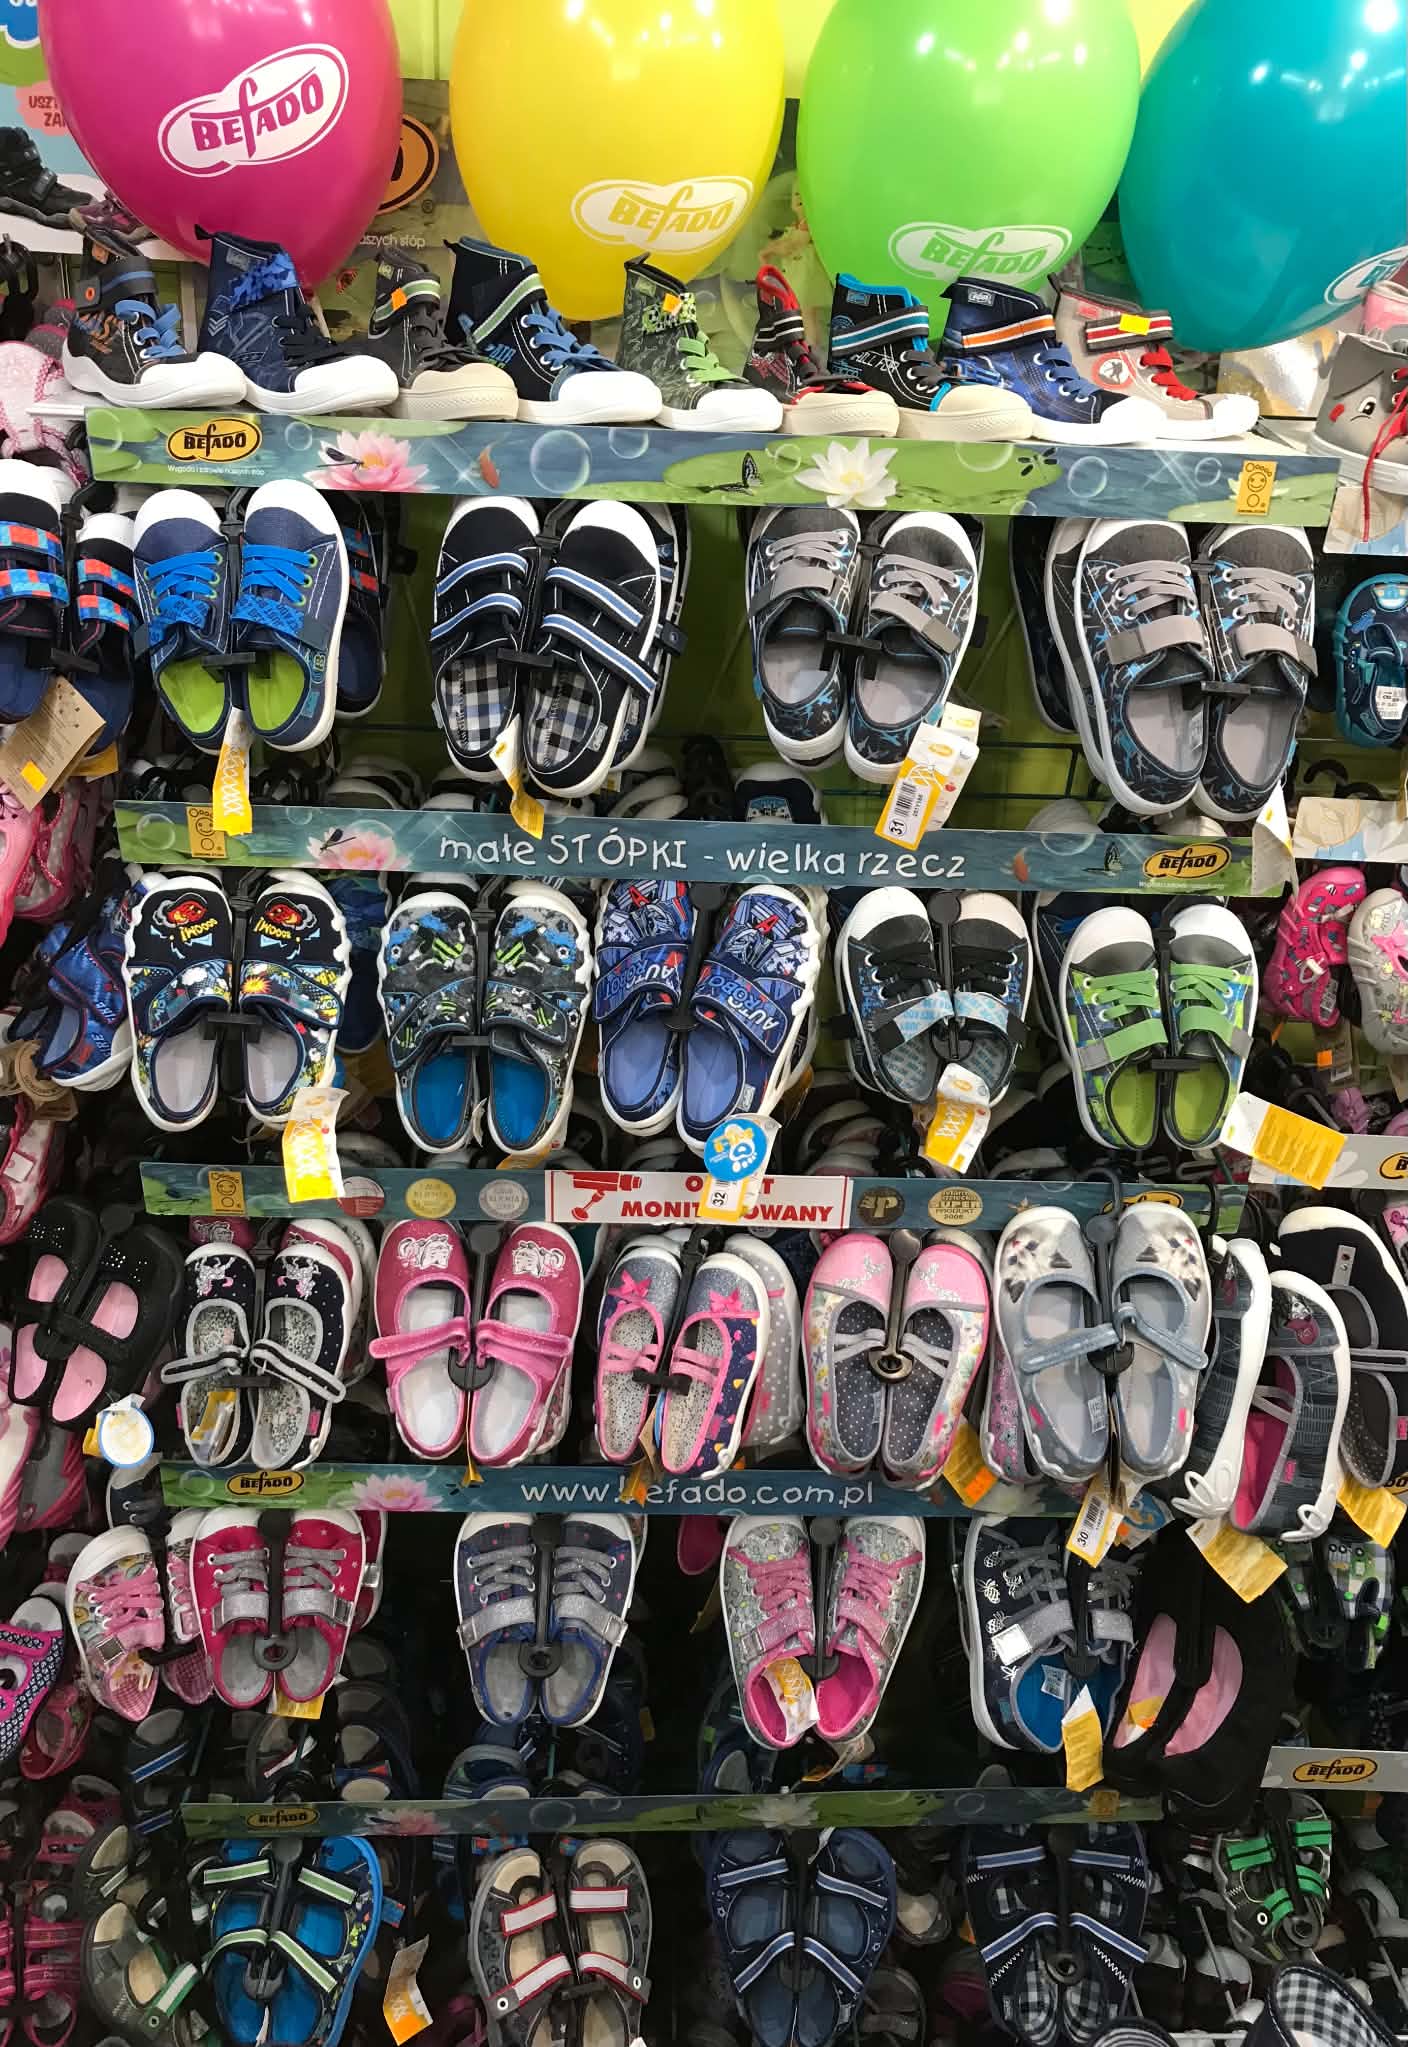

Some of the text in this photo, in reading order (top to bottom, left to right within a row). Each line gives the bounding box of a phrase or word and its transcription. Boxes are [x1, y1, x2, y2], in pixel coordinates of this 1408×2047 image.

[889, 819, 905, 836] 31
[439, 832, 536, 866] małe
[725, 841, 845, 875] wielka
[857, 850, 966, 879] rzecz
[712, 1191, 727, 1206] 32
[1076, 1531, 1089, 1546] 30
